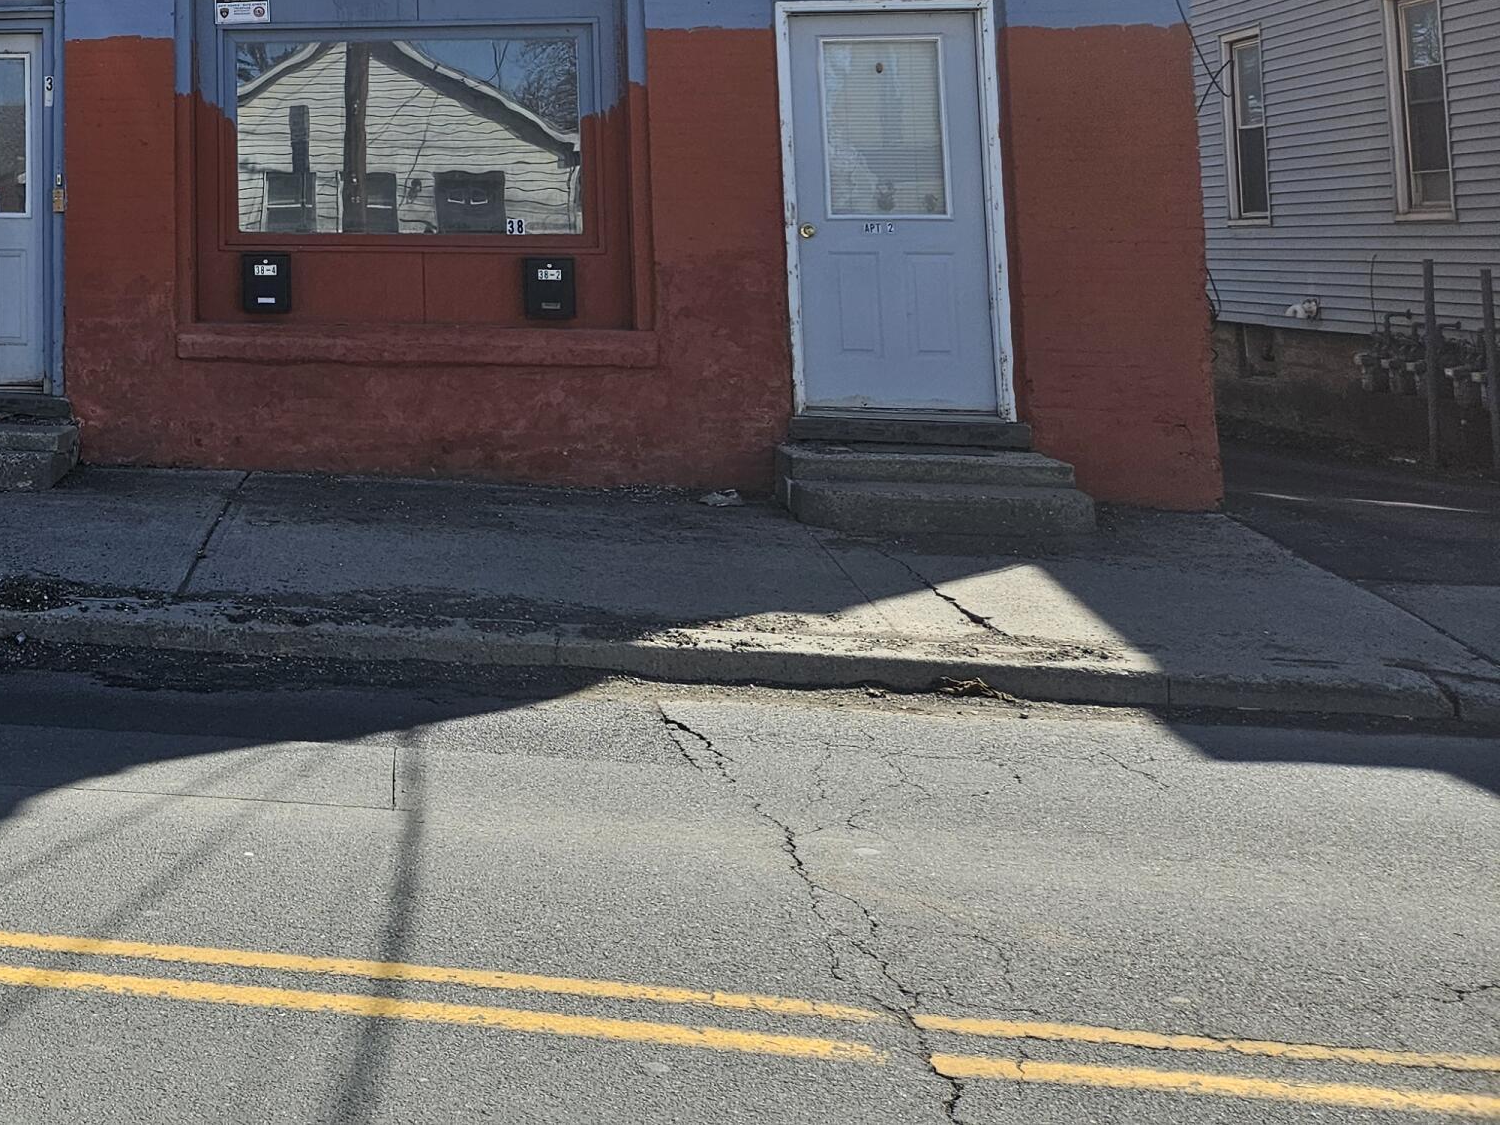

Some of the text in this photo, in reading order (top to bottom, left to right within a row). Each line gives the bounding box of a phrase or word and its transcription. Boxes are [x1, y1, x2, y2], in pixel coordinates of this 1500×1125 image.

[46, 76, 53, 91] 3
[507, 219, 524, 234] 38
[864, 223, 894, 233] APT 2
[255, 265, 276, 274] 38-4
[539, 270, 561, 279] 38-2
